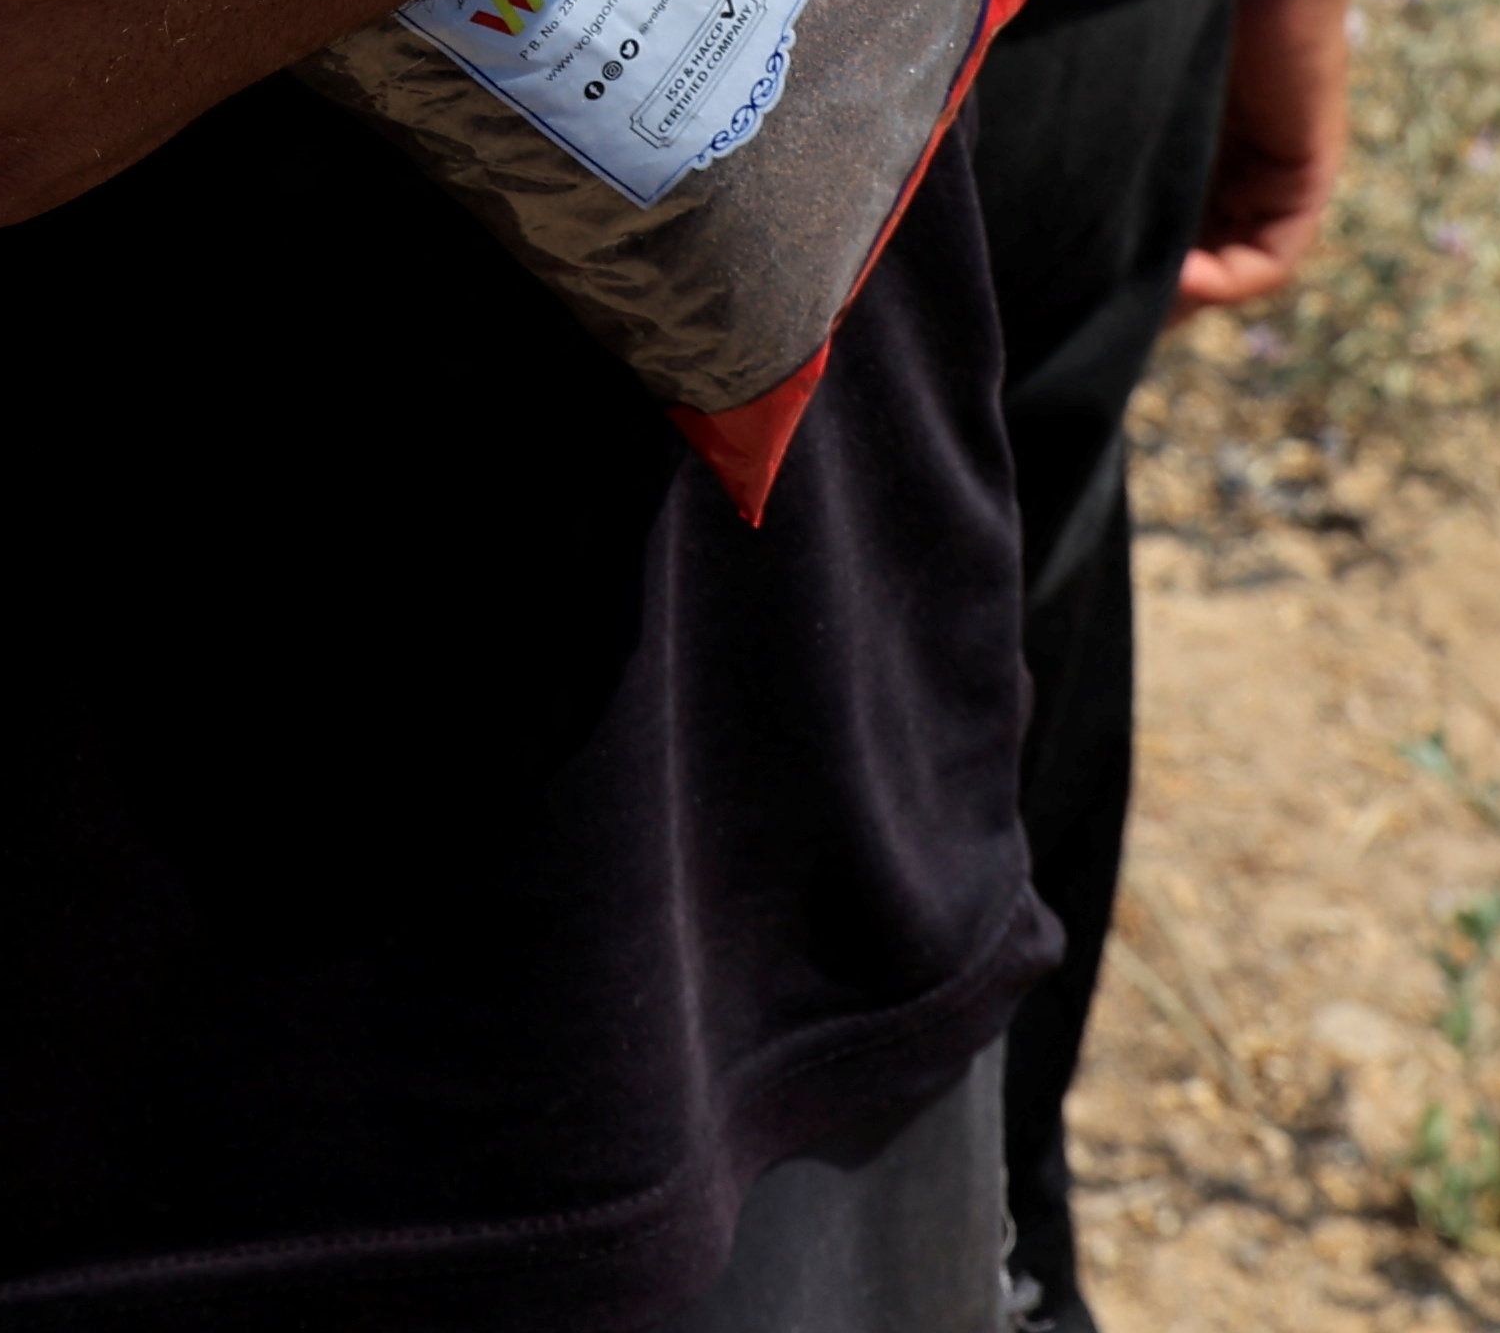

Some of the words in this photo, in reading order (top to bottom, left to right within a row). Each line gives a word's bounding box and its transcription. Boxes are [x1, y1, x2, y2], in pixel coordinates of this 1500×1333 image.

[539, 13, 564, 40] No:
[687, 18, 728, 67] HACCP
[654, 67, 711, 135] CERTIFIED
[702, 2, 757, 72] COMPANY
[680, 63, 696, 79] &
[662, 74, 687, 102] ISO
